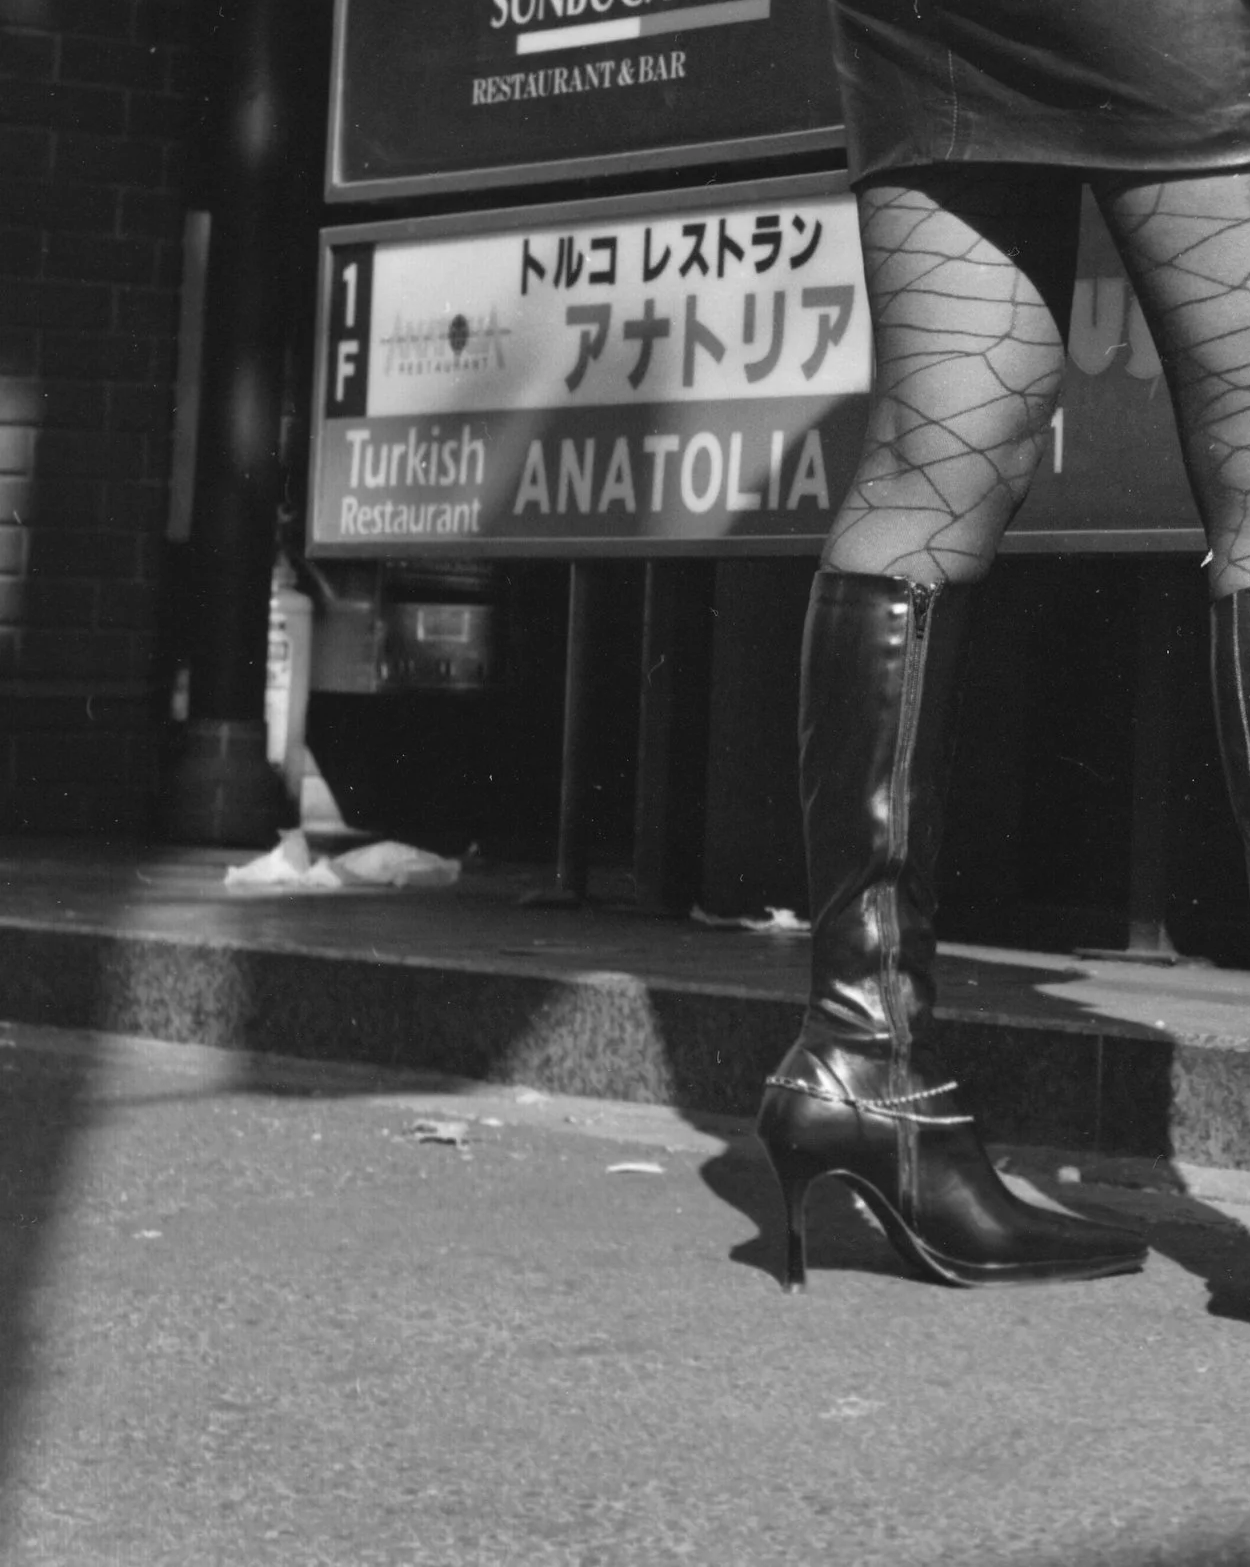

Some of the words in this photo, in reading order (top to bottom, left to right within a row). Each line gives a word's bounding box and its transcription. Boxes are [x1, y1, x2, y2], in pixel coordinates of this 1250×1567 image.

[564, 284, 856, 394] アナトリア
[346, 423, 484, 488] Turkish
[513, 429, 830, 515] ANATOLIA
[340, 495, 482, 535] Restaurant
